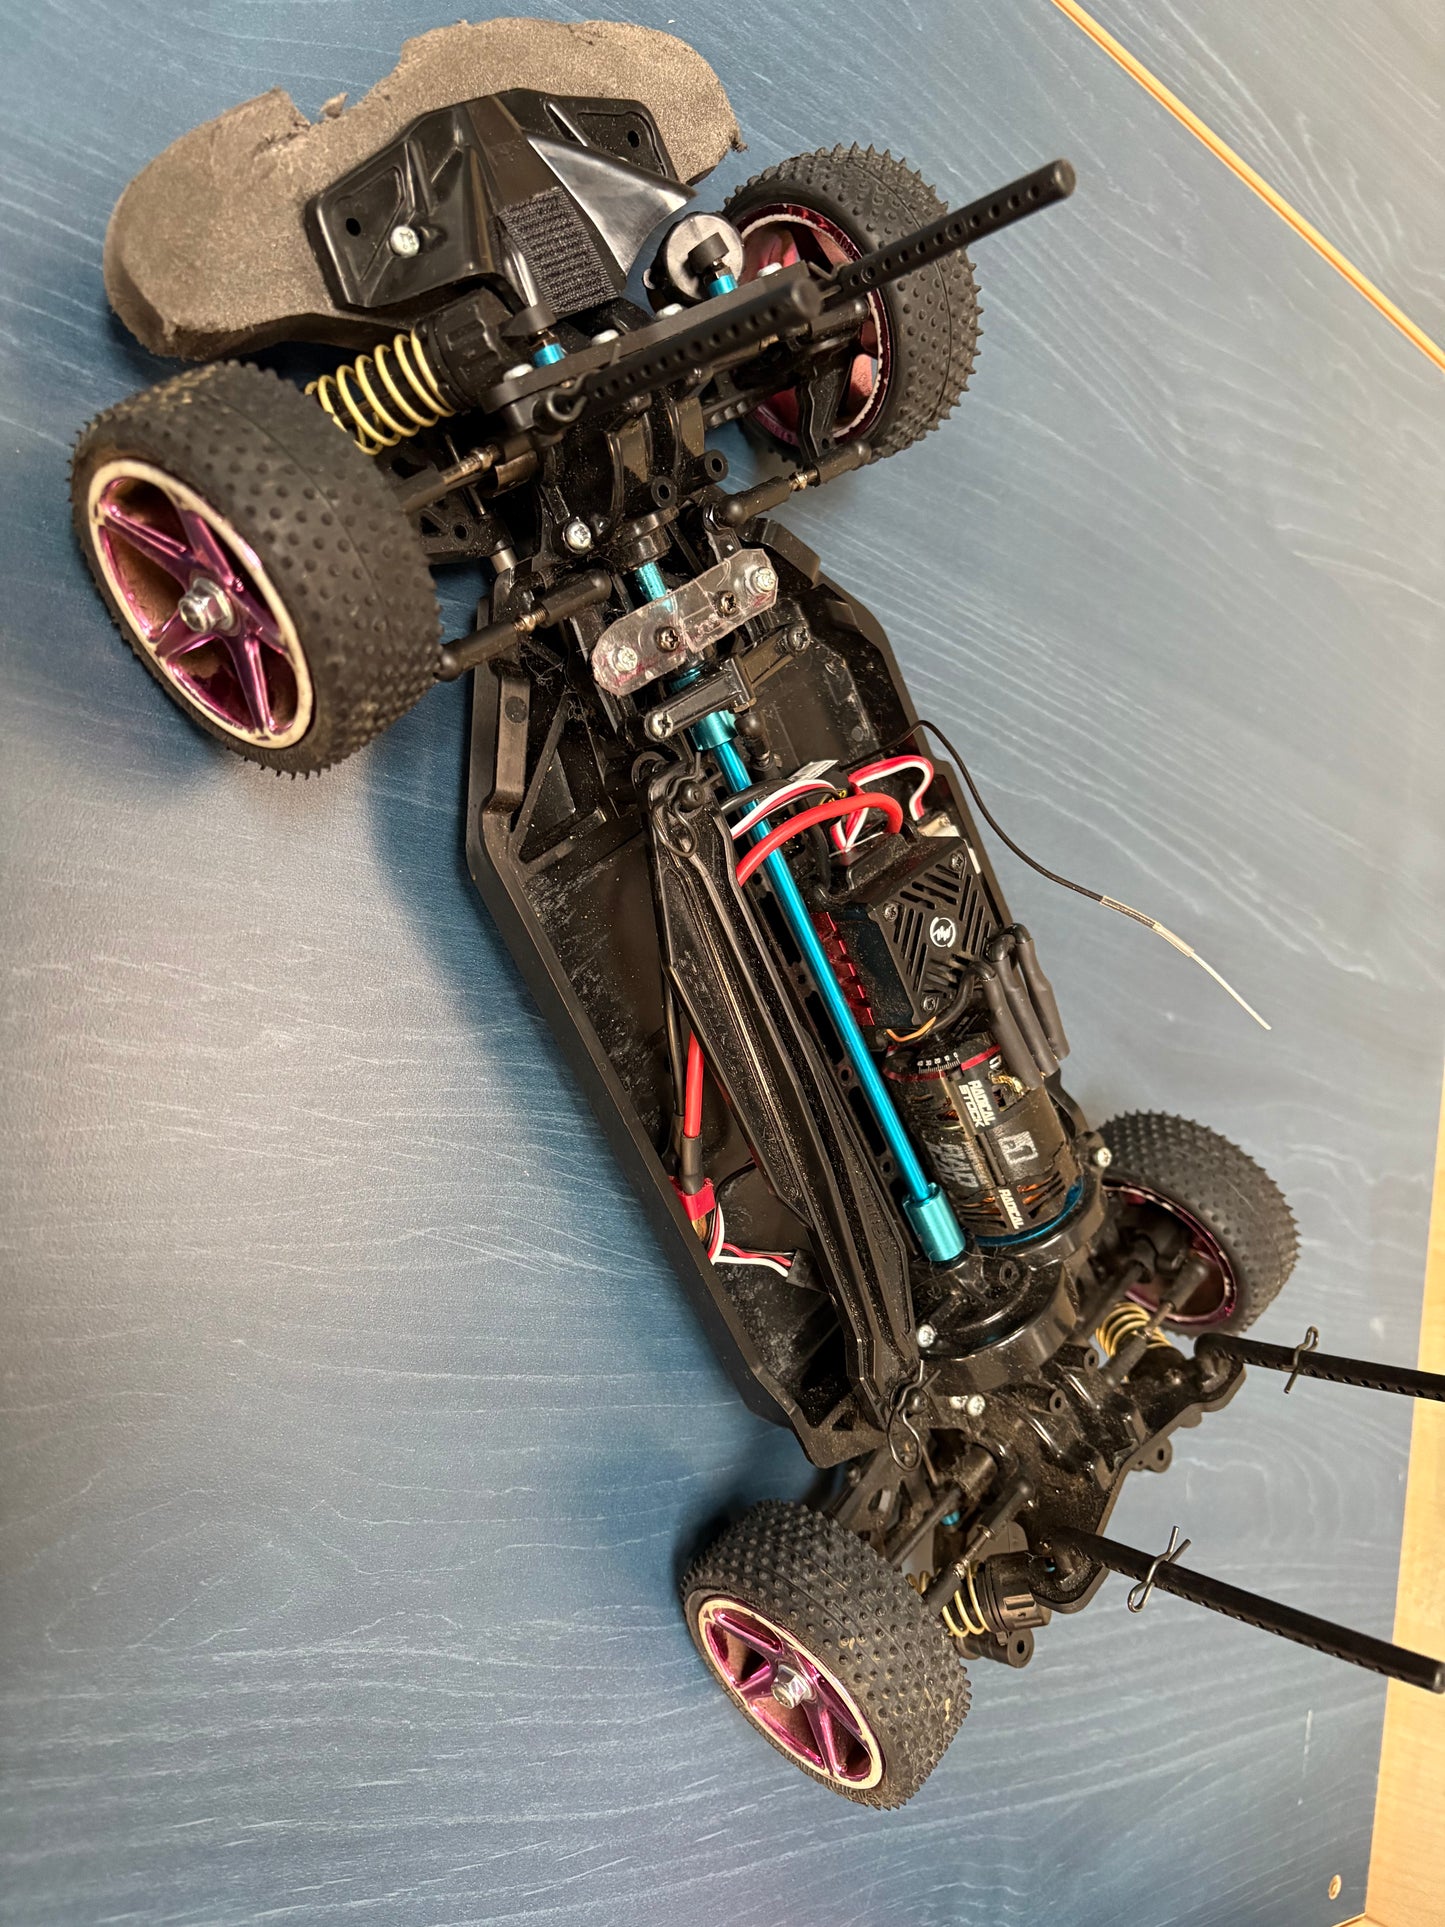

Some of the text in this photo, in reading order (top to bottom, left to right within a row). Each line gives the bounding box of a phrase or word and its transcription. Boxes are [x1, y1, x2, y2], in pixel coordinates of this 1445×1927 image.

[959, 1085, 985, 1128] STOCK
[968, 1080, 996, 1126] RADICAL
[998, 1189, 1024, 1229] RADICAL
